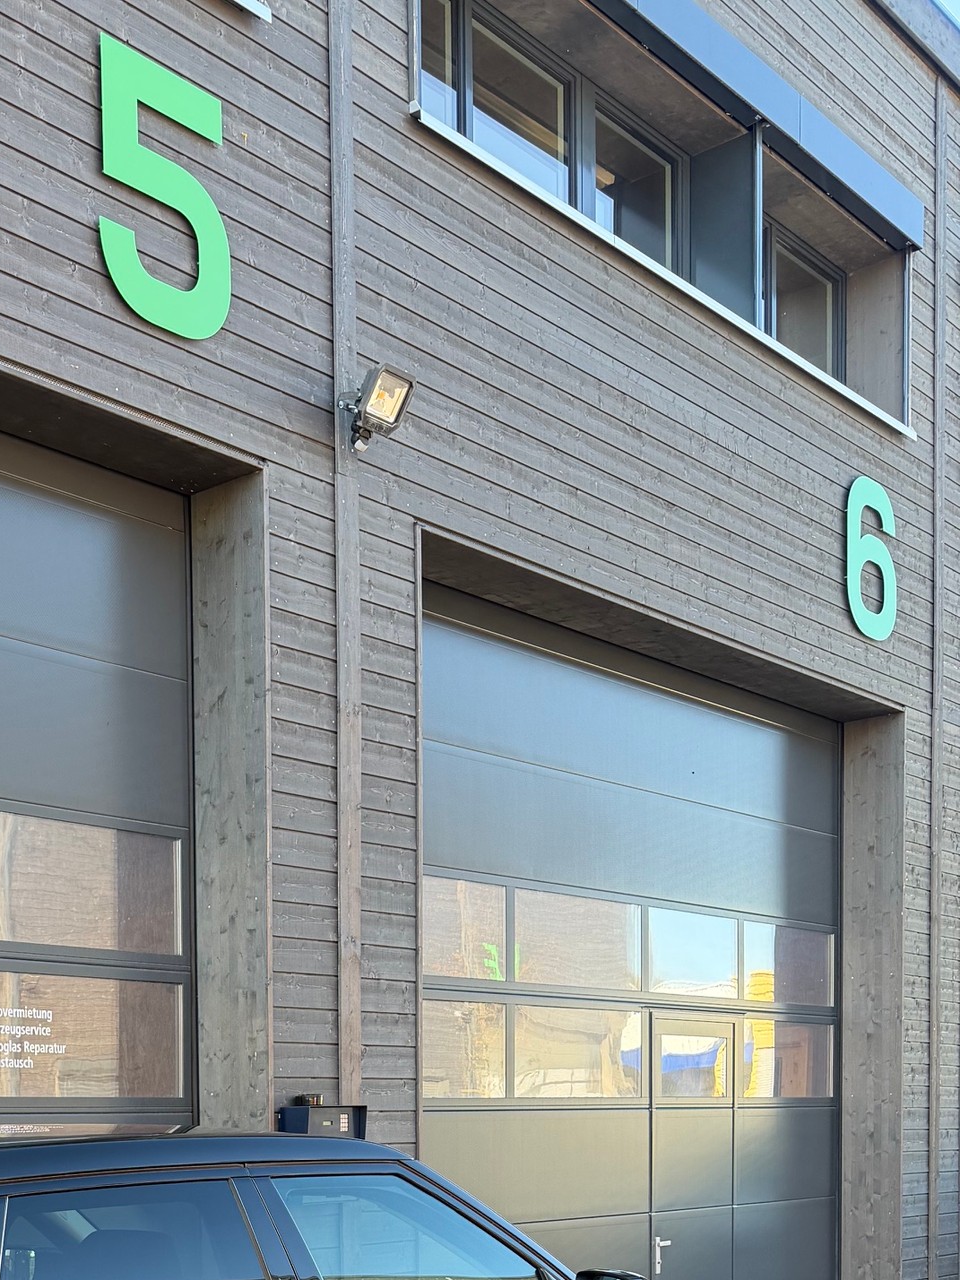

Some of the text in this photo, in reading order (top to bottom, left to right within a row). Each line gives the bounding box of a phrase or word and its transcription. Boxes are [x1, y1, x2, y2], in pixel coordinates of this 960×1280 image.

[98, 31, 232, 341] 5
[846, 475, 897, 641] 6
[23, 1041, 67, 1056] Reparatur
